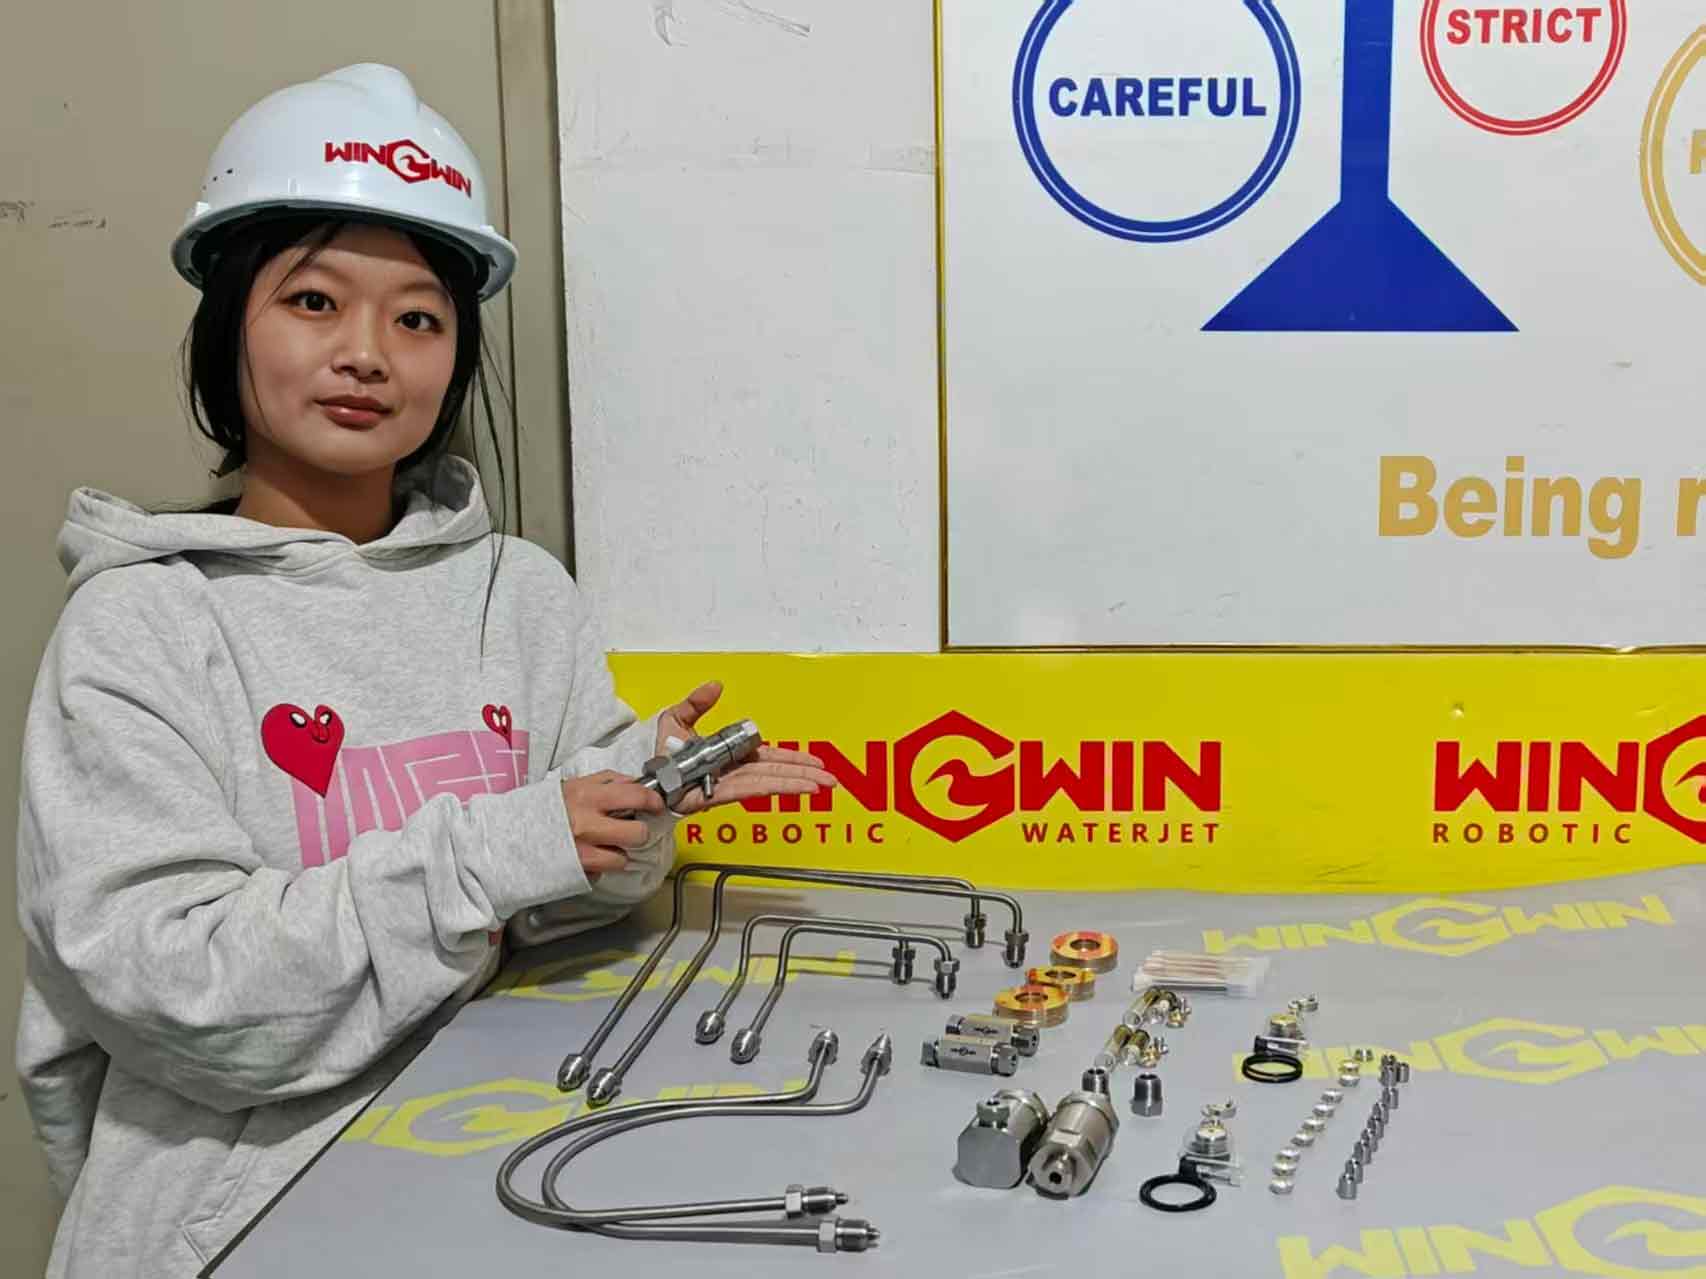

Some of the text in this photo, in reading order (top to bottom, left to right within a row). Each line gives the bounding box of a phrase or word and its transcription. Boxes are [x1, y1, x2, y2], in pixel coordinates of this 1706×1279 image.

[1446, 7, 1603, 45] STRICT
[1048, 77, 1267, 118] CAREFUL
[1378, 456, 1643, 560] Being
[686, 822, 1220, 844] ROBOTIC WATERJET
[1433, 823, 1631, 844] ROBOTIC
[1202, 897, 1675, 957] WINGWIN
